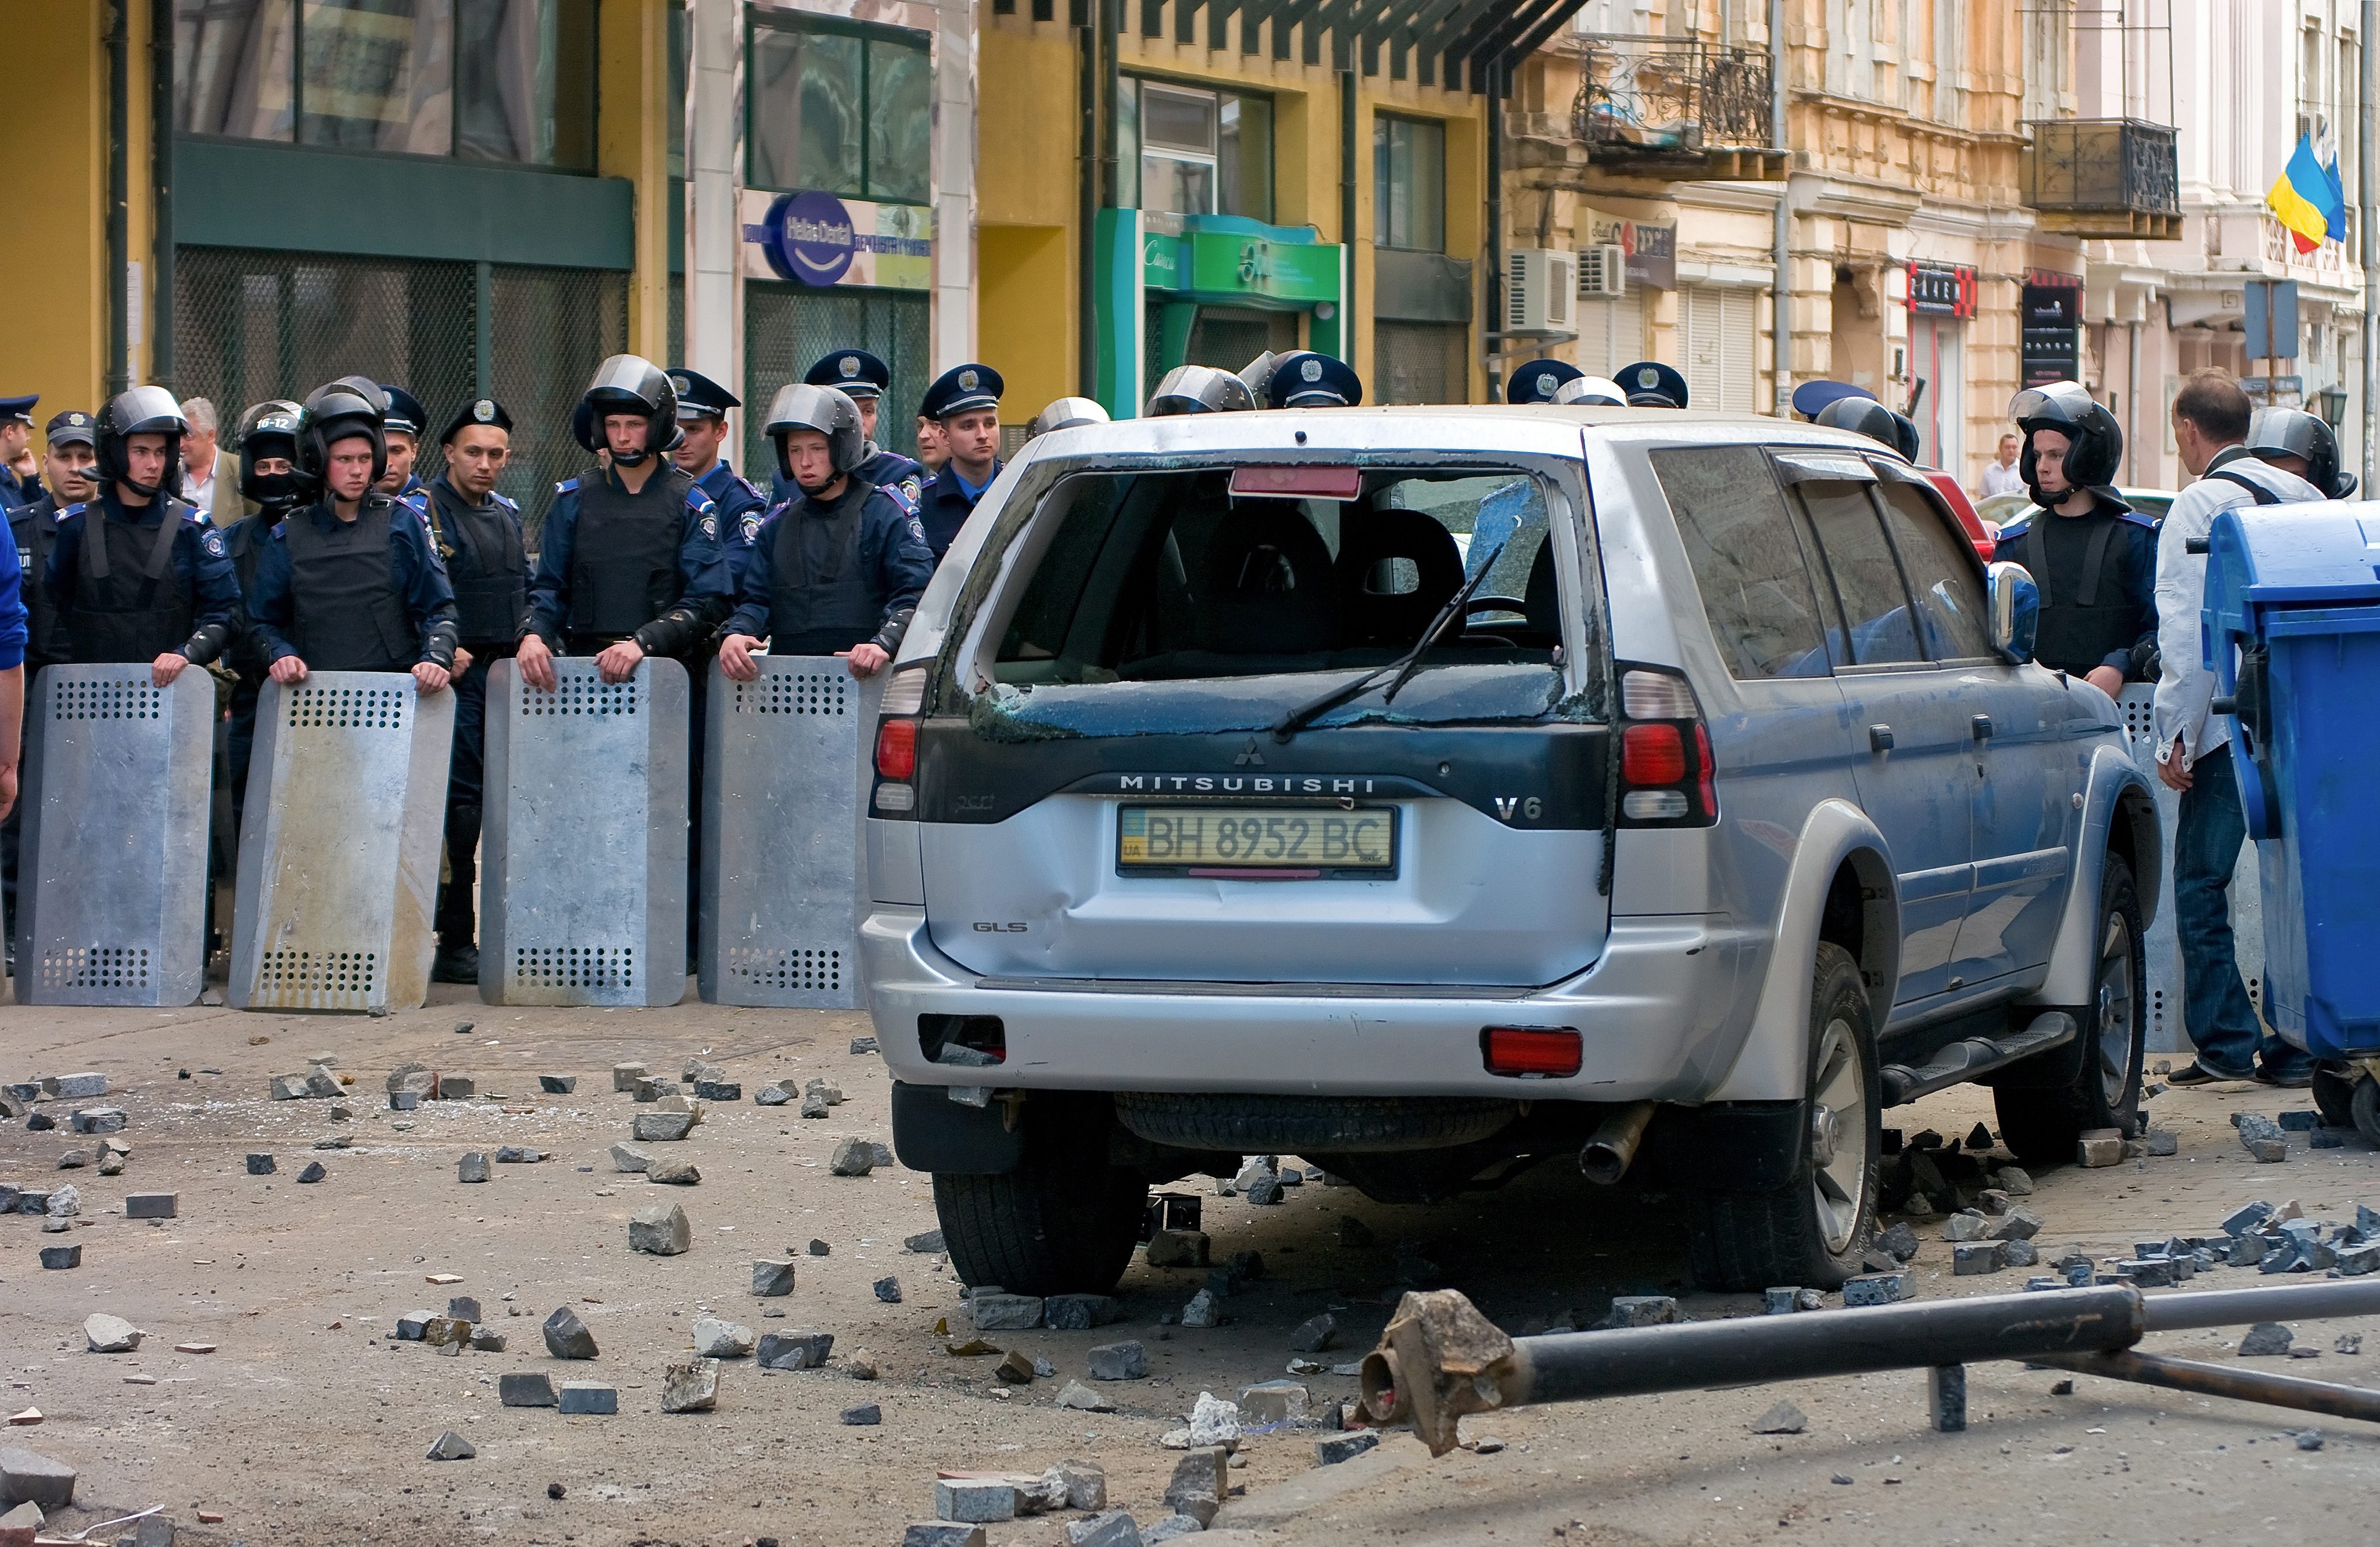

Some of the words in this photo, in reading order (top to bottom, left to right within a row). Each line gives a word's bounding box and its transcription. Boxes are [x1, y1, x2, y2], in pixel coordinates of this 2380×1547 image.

[256, 418, 289, 430] 16-12
[1120, 776, 1373, 793] MITSUBISHI
[1148, 816, 1203, 858] BH
[1215, 817, 1309, 860] 8952
[1322, 818, 1379, 859] BC
[1123, 845, 1140, 856] UA
[972, 921, 1028, 934] GLS
